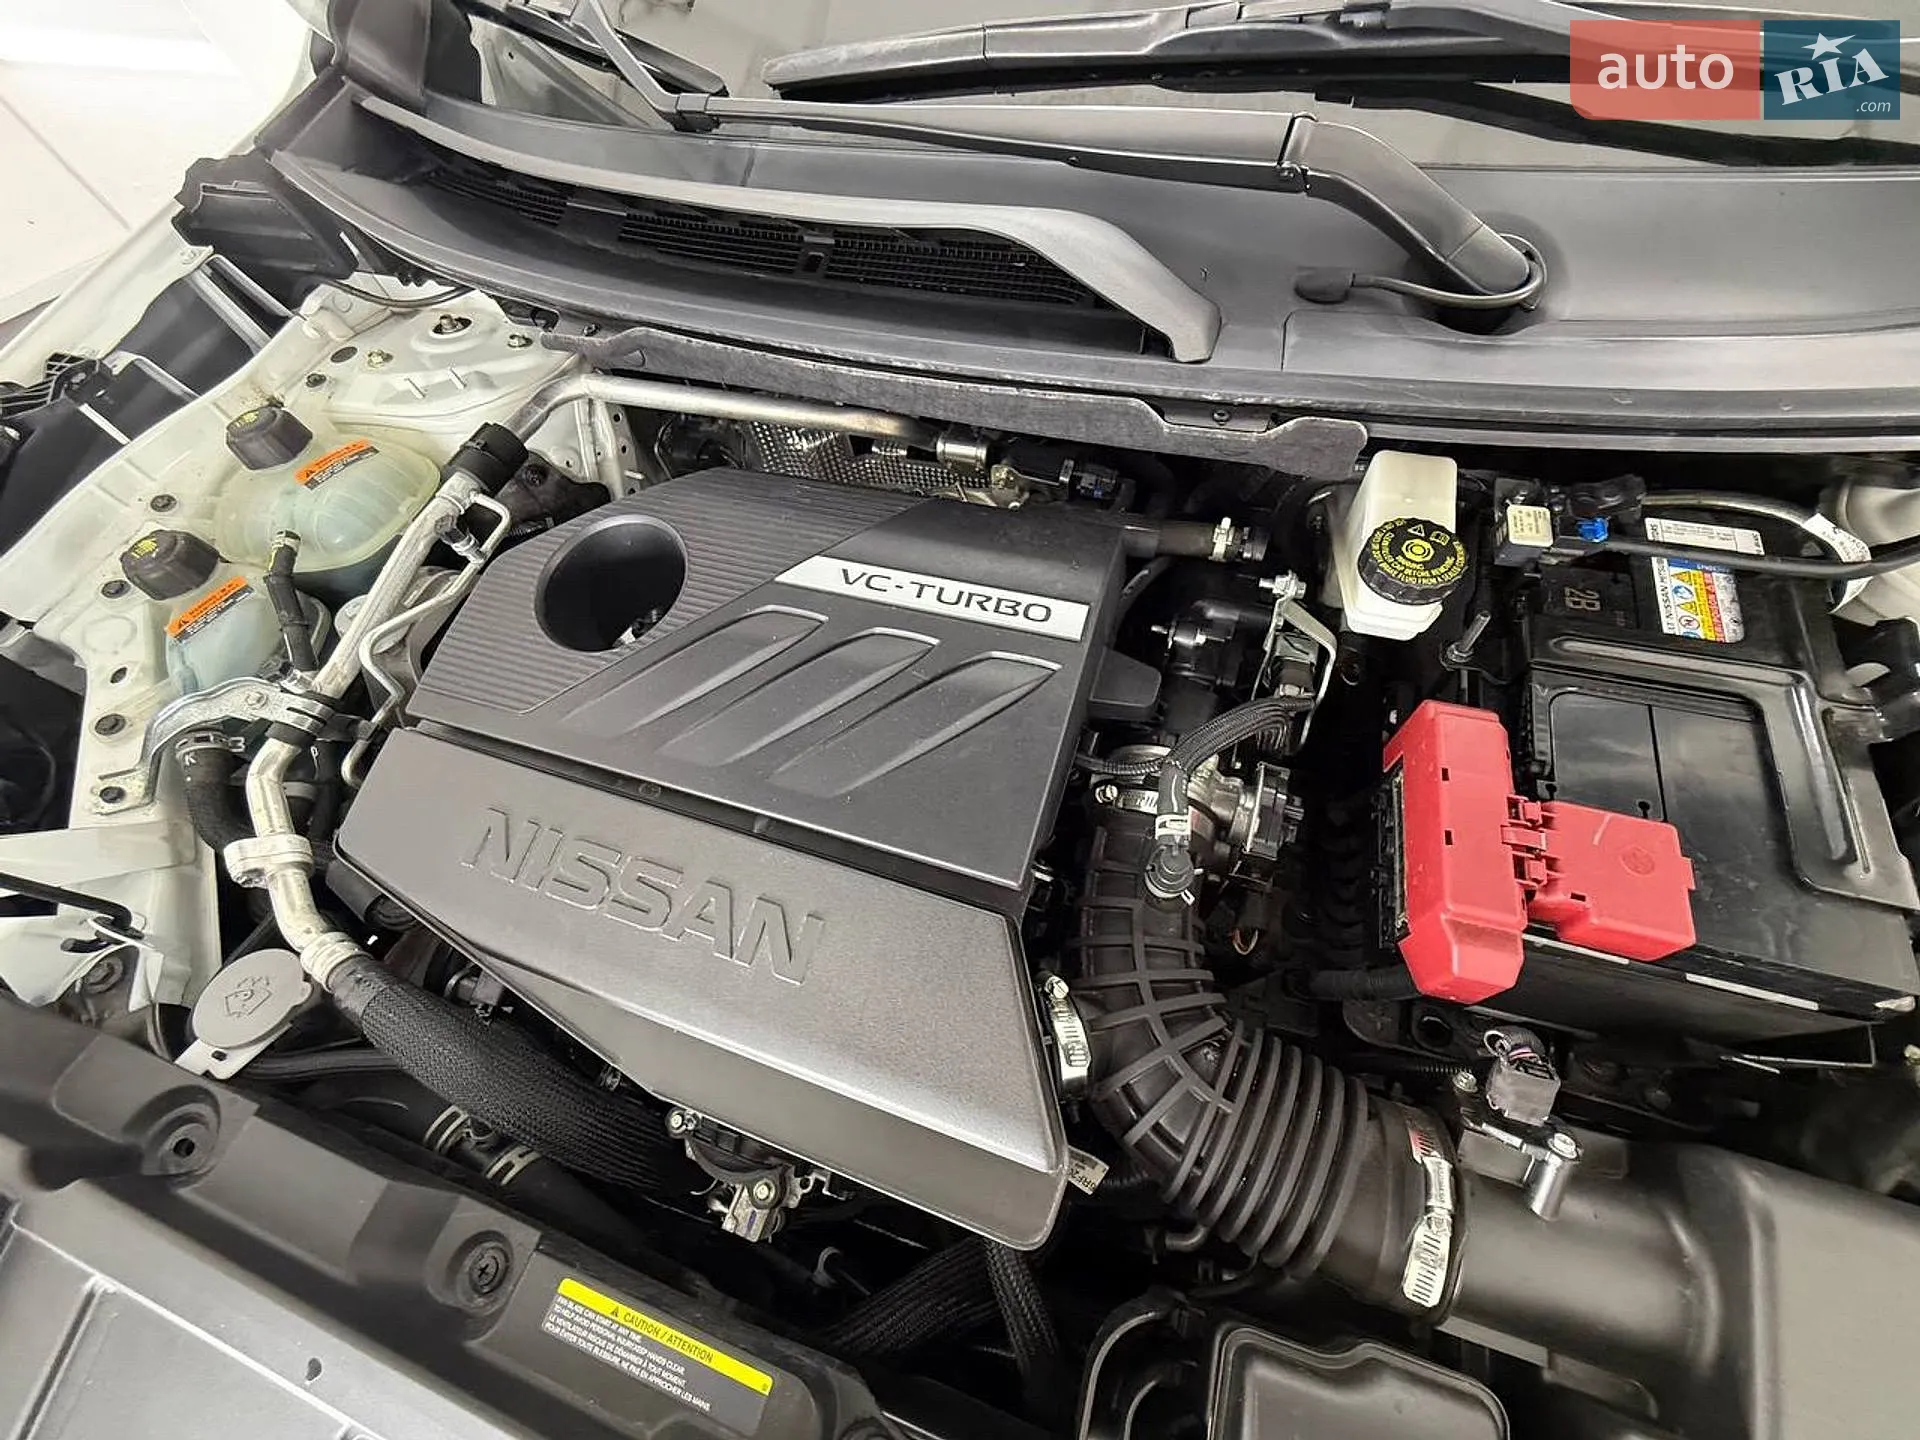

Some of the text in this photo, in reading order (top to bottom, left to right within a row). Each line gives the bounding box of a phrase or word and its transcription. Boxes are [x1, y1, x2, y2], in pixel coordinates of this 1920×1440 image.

[840, 567, 1053, 623] VC-TURBO
[460, 807, 826, 985] NISSAN
[623, 1311, 662, 1337] CAUTION
[667, 1333, 714, 1363] ATTENTION
